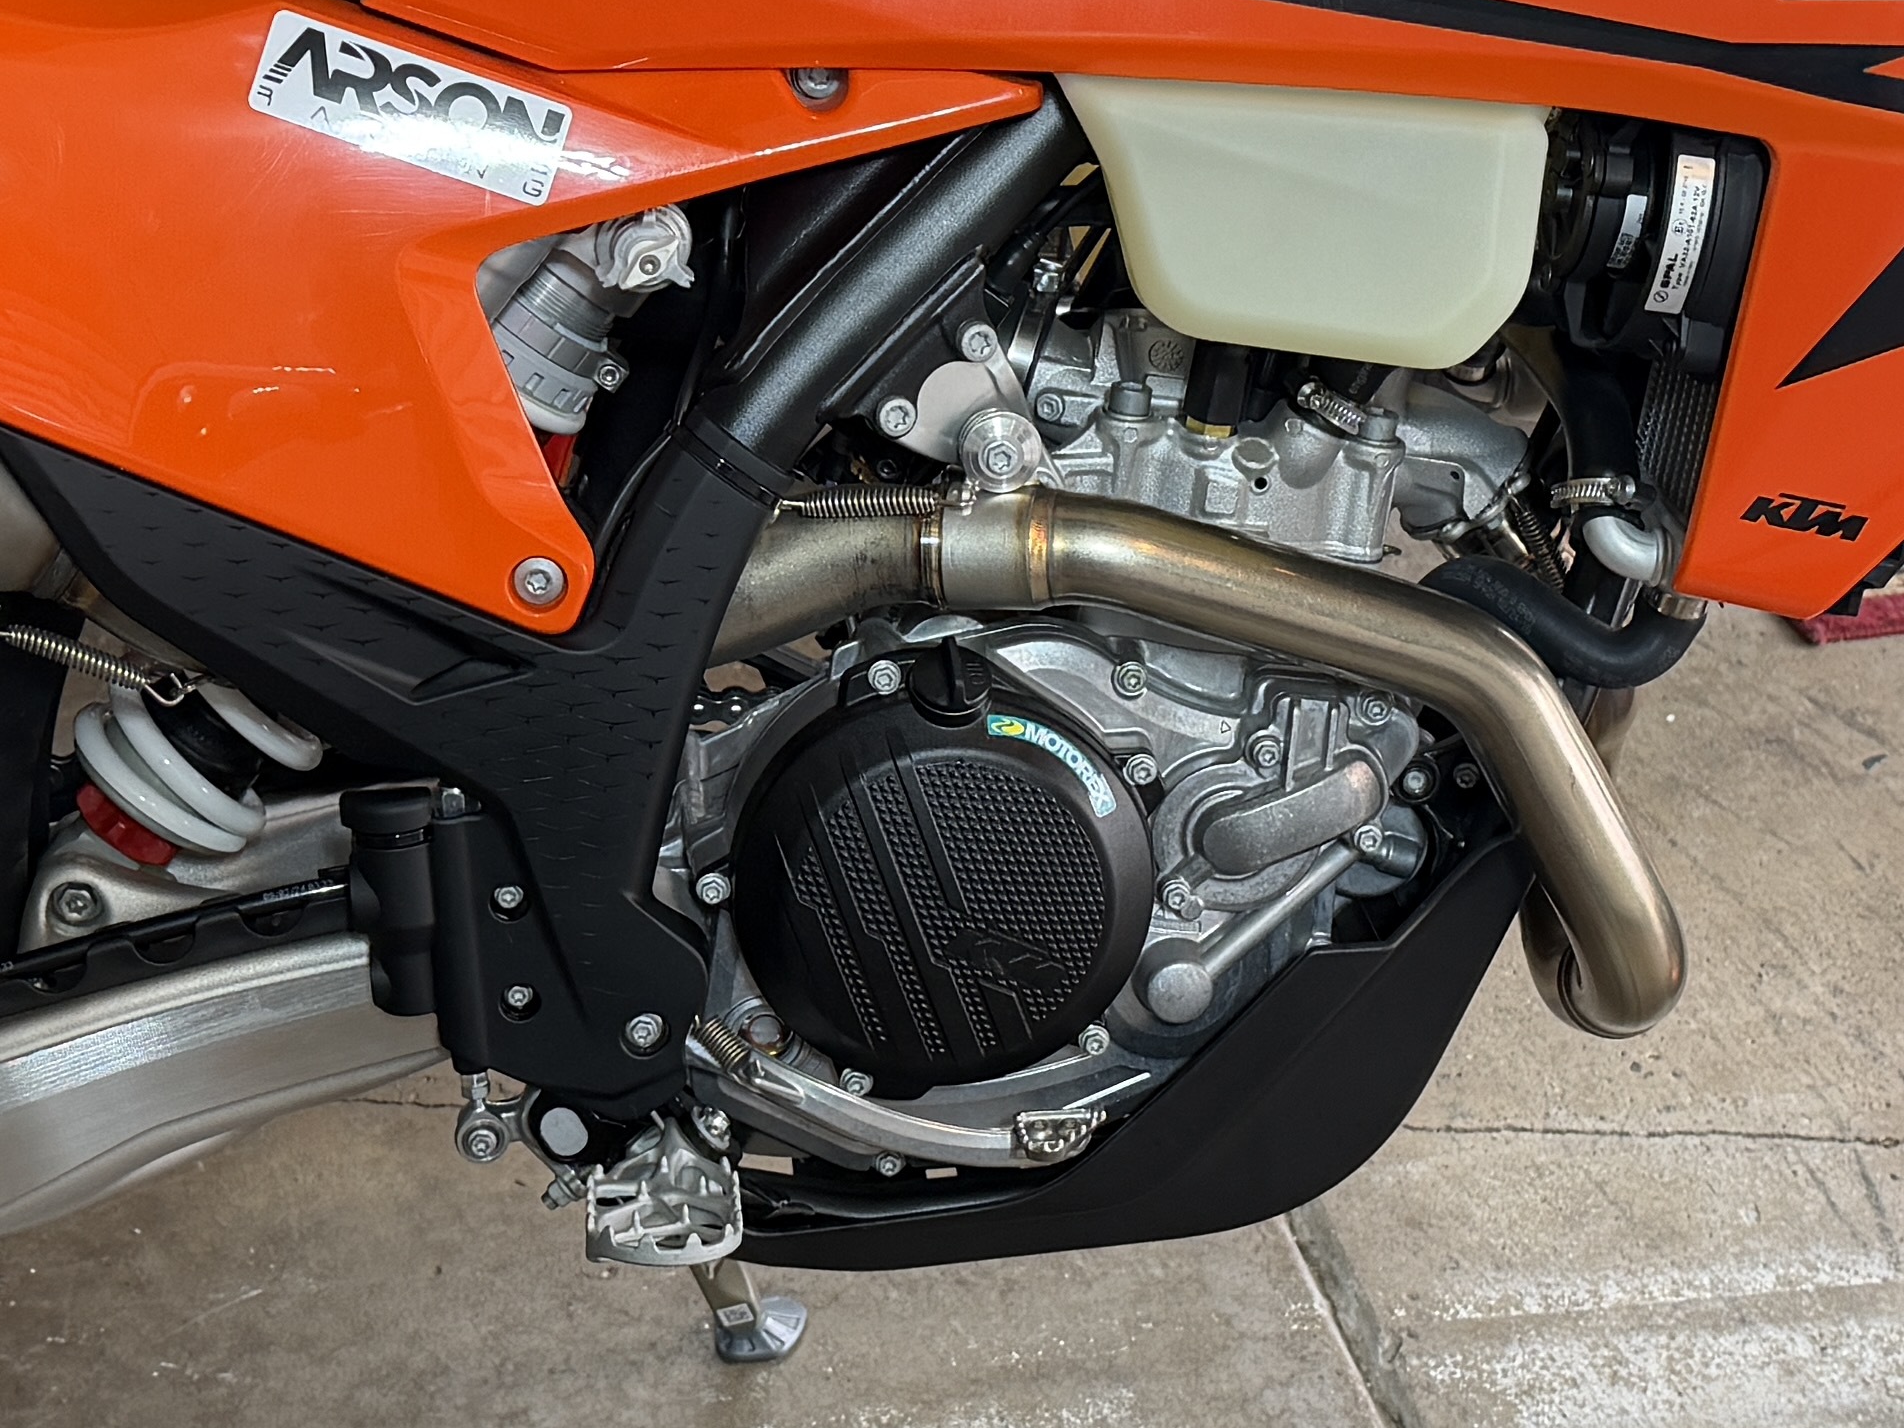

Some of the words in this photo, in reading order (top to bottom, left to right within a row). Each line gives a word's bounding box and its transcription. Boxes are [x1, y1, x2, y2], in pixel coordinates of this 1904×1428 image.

[263, 27, 566, 143] ARSON
[1660, 252, 1678, 288] SPAL
[1740, 492, 1869, 542] KTM
[1024, 722, 1110, 808] MOTOREX
